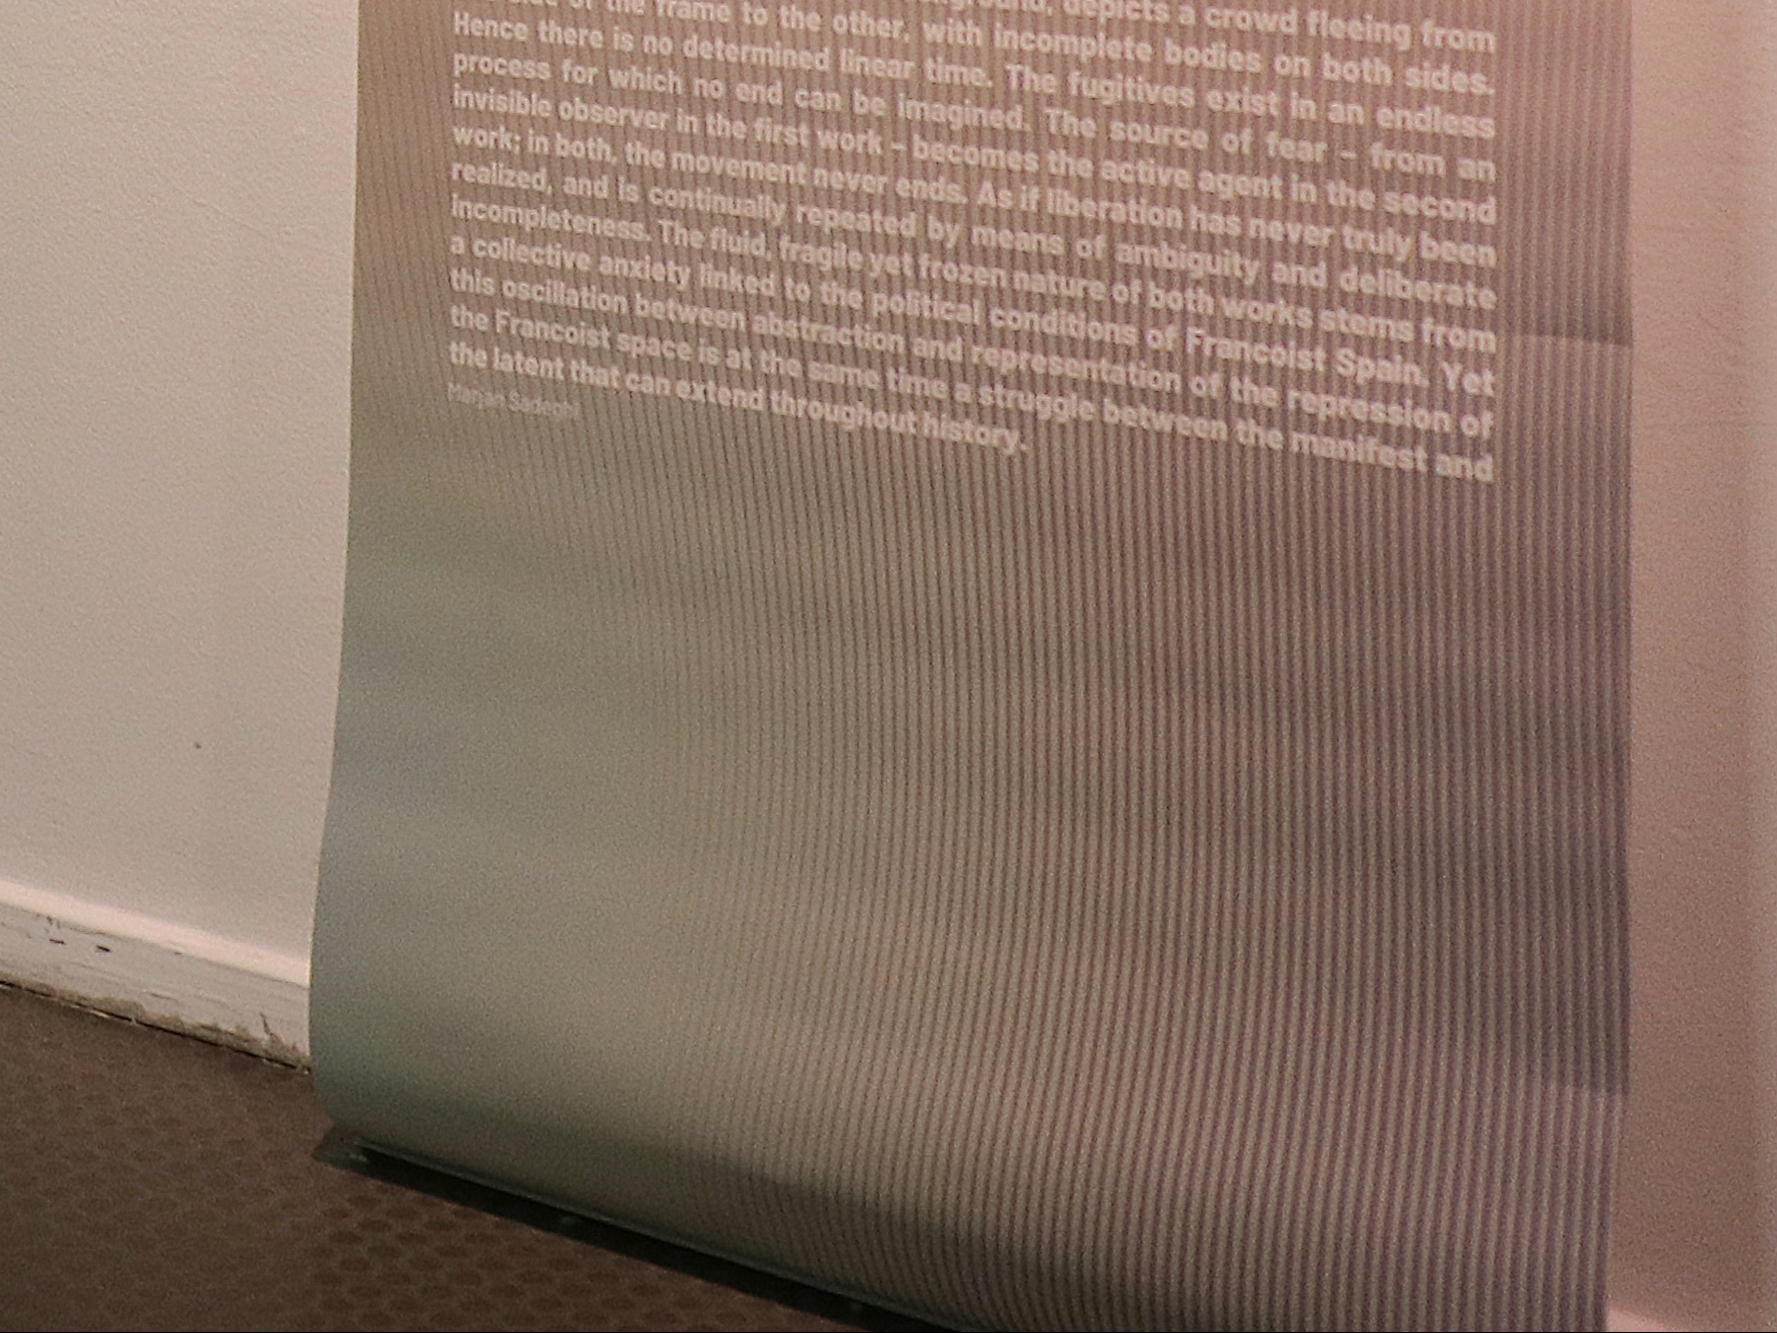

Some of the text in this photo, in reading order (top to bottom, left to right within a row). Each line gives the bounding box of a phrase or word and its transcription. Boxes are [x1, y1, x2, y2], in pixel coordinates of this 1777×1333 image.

[1179, 6, 1195, 25] a
[1205, 8, 1297, 33] crowd
[1308, 11, 1410, 51] fleeing
[1422, 21, 1495, 51] from
[450, 340, 1027, 454] the latent that can extend throughout history.
